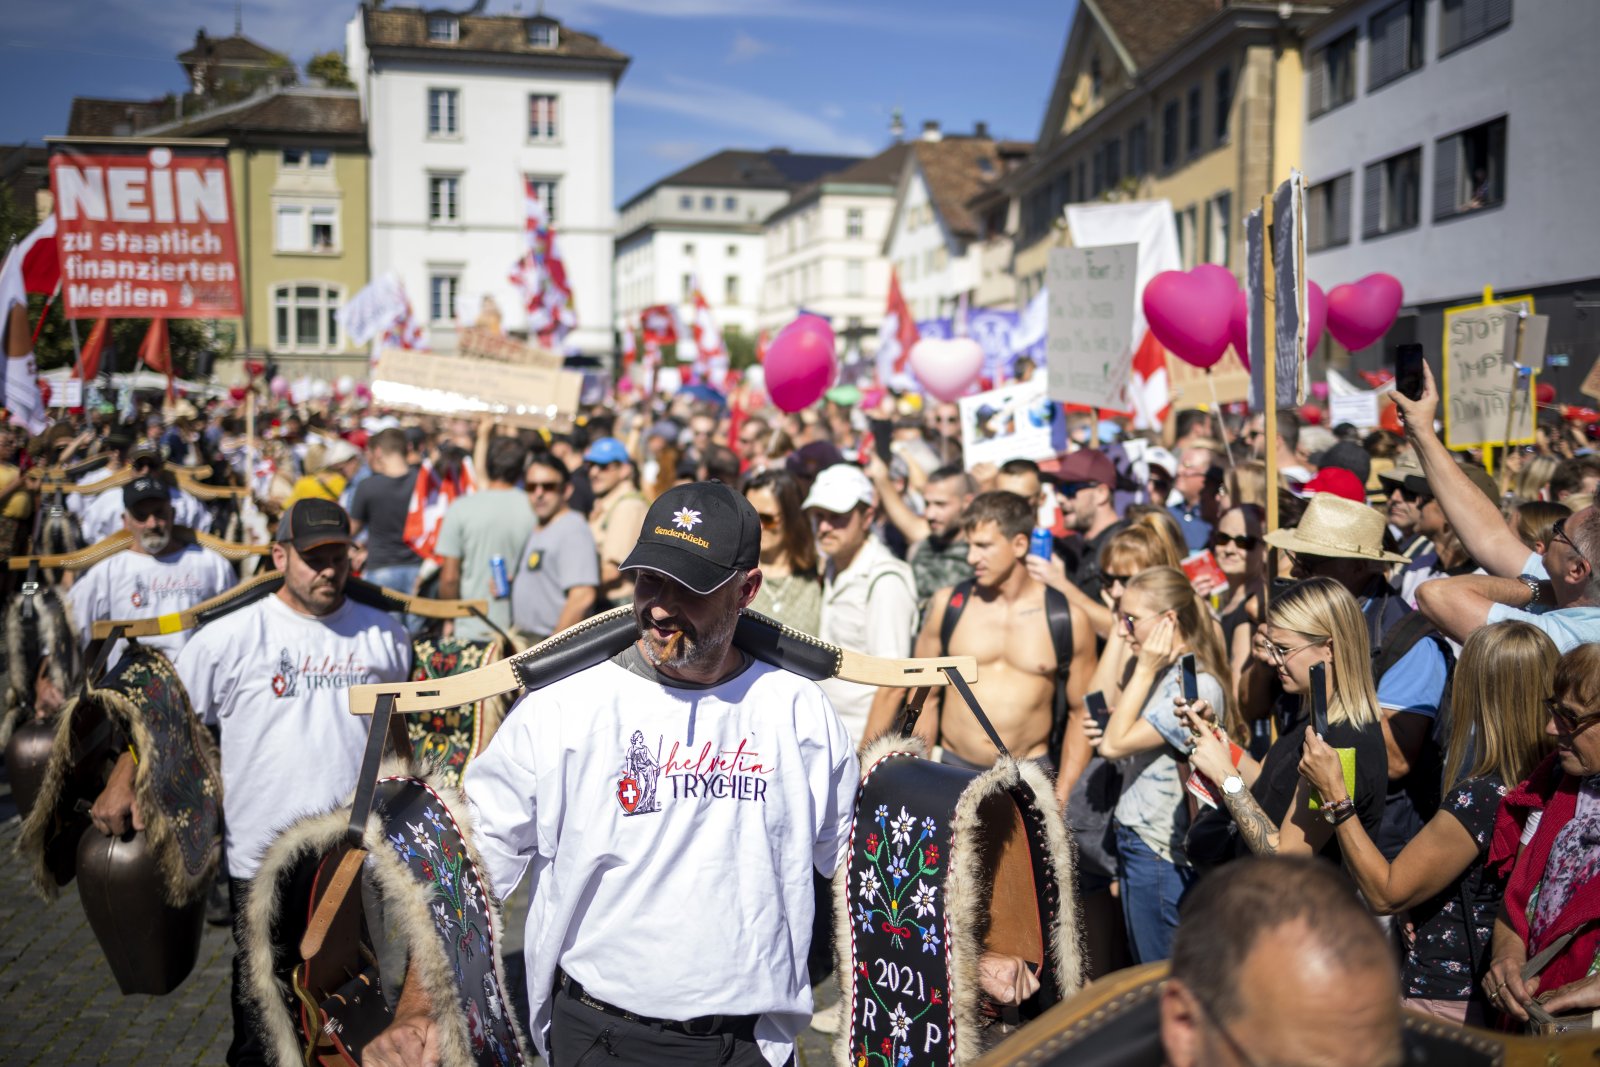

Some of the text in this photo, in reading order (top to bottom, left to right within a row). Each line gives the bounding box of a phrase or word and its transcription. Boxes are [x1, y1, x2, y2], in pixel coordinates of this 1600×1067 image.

[62, 228, 222, 255] zu staatlich
[64, 254, 236, 282] finanzierten
[68, 282, 168, 308] Medien
[660, 738, 775, 786] helvetia
[665, 773, 768, 803] TRYCHLER
[874, 957, 926, 1002] 2021
[862, 997, 942, 1053] R P
